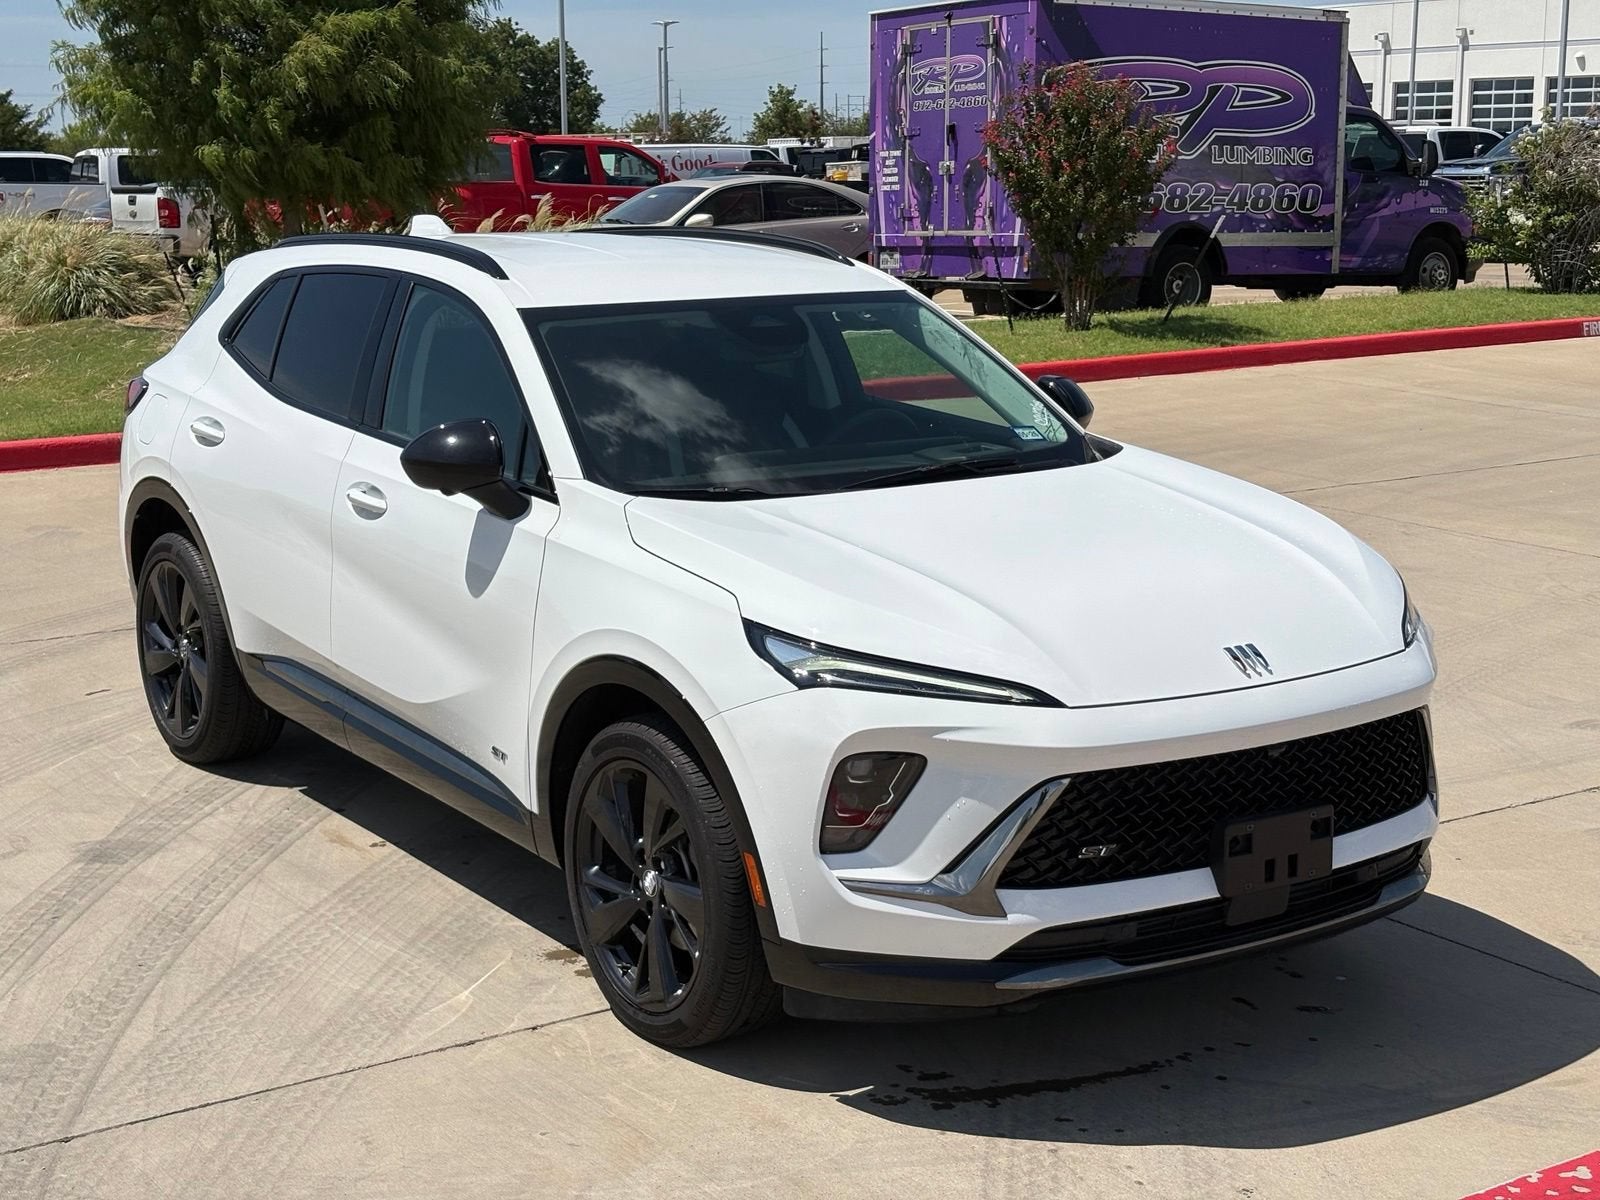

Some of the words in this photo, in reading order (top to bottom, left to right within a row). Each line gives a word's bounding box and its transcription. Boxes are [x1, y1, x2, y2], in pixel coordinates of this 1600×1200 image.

[671, 154, 713, 171] Good
[1211, 144, 1314, 166] LUMBING
[1582, 320, 1600, 336] FIR
